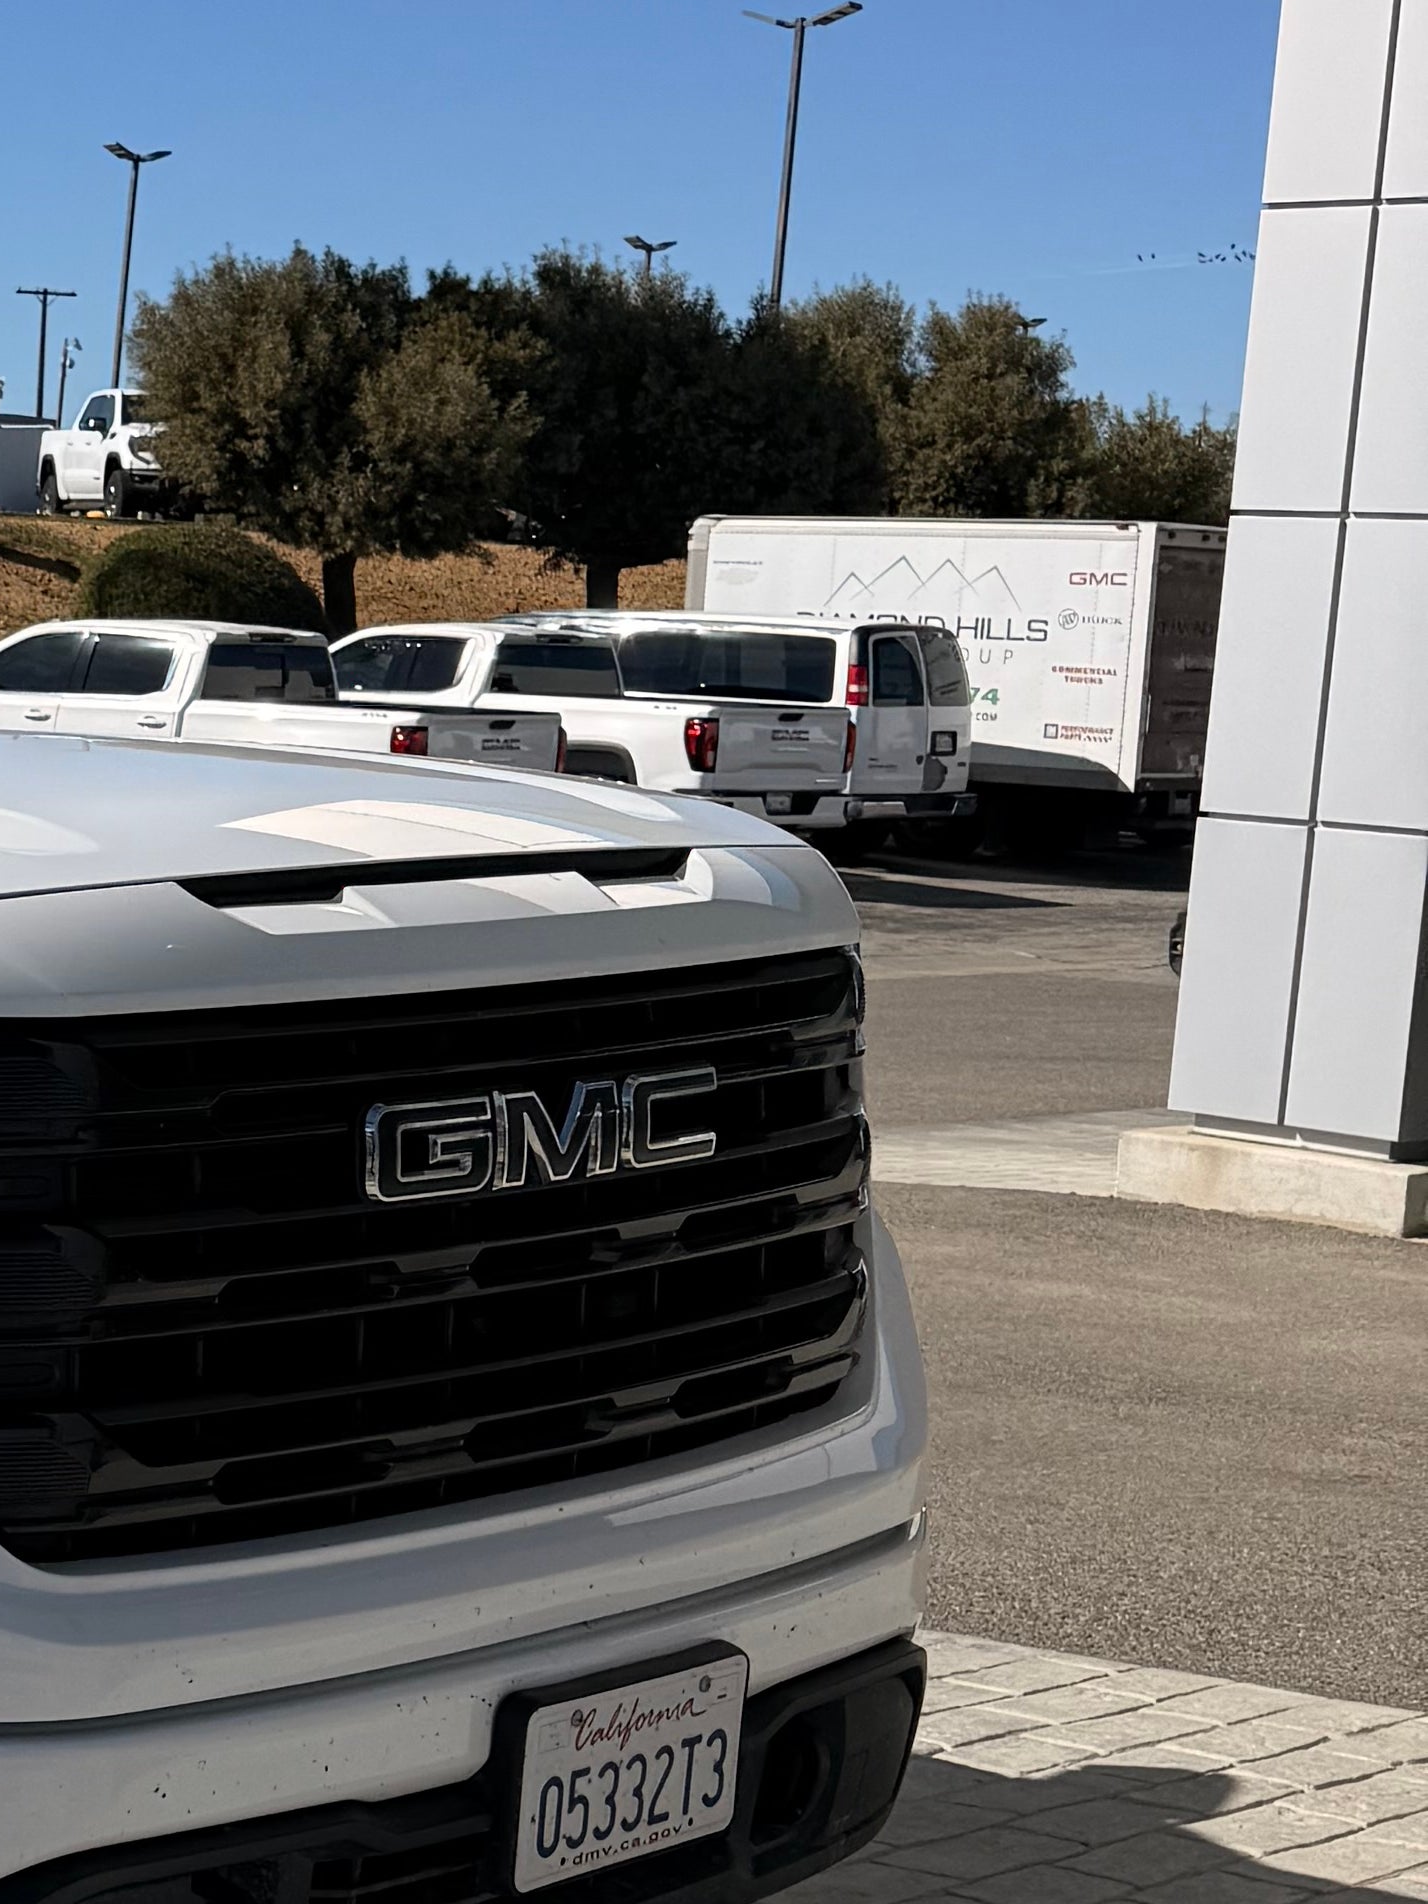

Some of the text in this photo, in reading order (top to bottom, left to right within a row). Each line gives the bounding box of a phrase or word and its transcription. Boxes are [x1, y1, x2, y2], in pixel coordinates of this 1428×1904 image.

[1069, 572, 1128, 586] GMC
[956, 616, 1049, 642] HILLS
[365, 1066, 718, 1202] GMC
[574, 1696, 707, 1752] California
[536, 1728, 728, 1859] 05332T3
[572, 1823, 683, 1867] dmv.ca.gov
